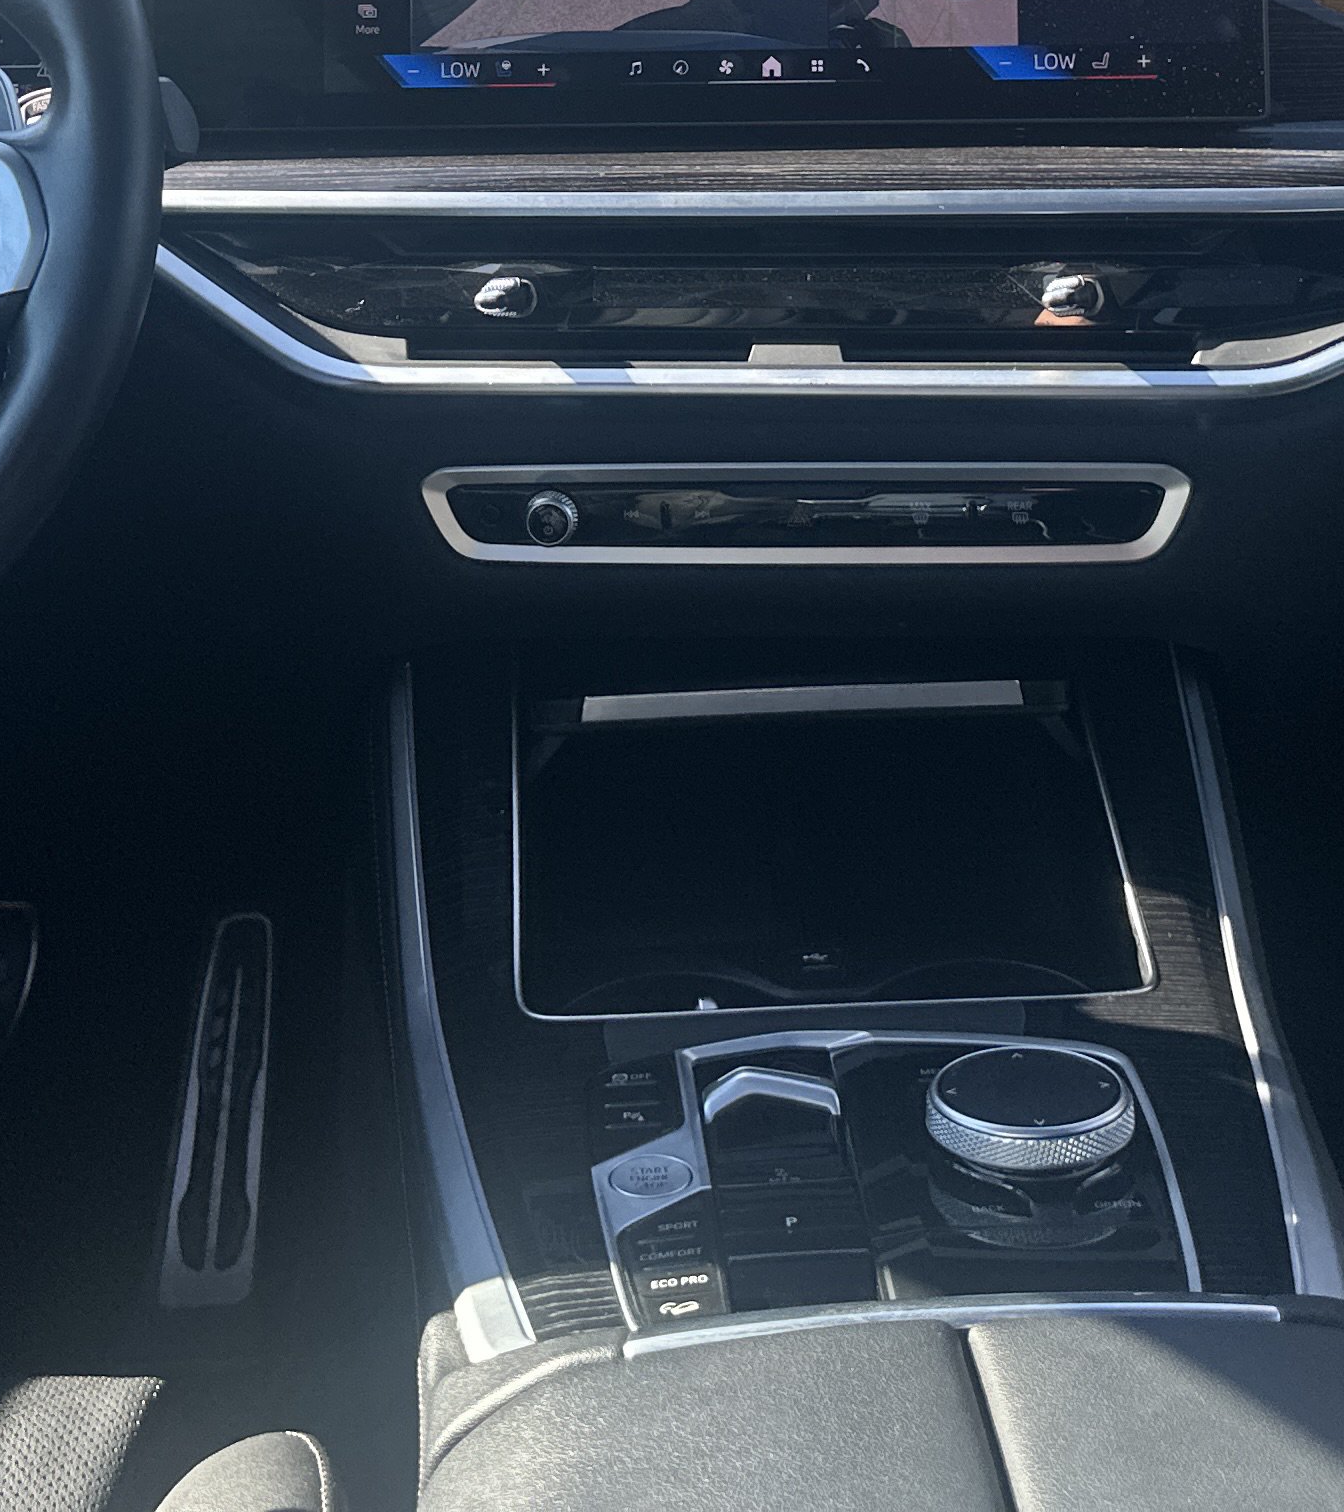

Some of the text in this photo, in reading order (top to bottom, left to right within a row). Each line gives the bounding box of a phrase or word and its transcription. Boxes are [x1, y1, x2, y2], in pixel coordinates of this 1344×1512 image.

[355, 24, 381, 35] More
[1033, 52, 1076, 70] LOW
[440, 61, 481, 79] LOW
[1007, 501, 1033, 511] REAR
[657, 1220, 699, 1232] SPORT
[785, 1216, 798, 1227] P
[639, 1246, 704, 1262] COMFORT
[650, 1274, 709, 1290] ECO PRO
